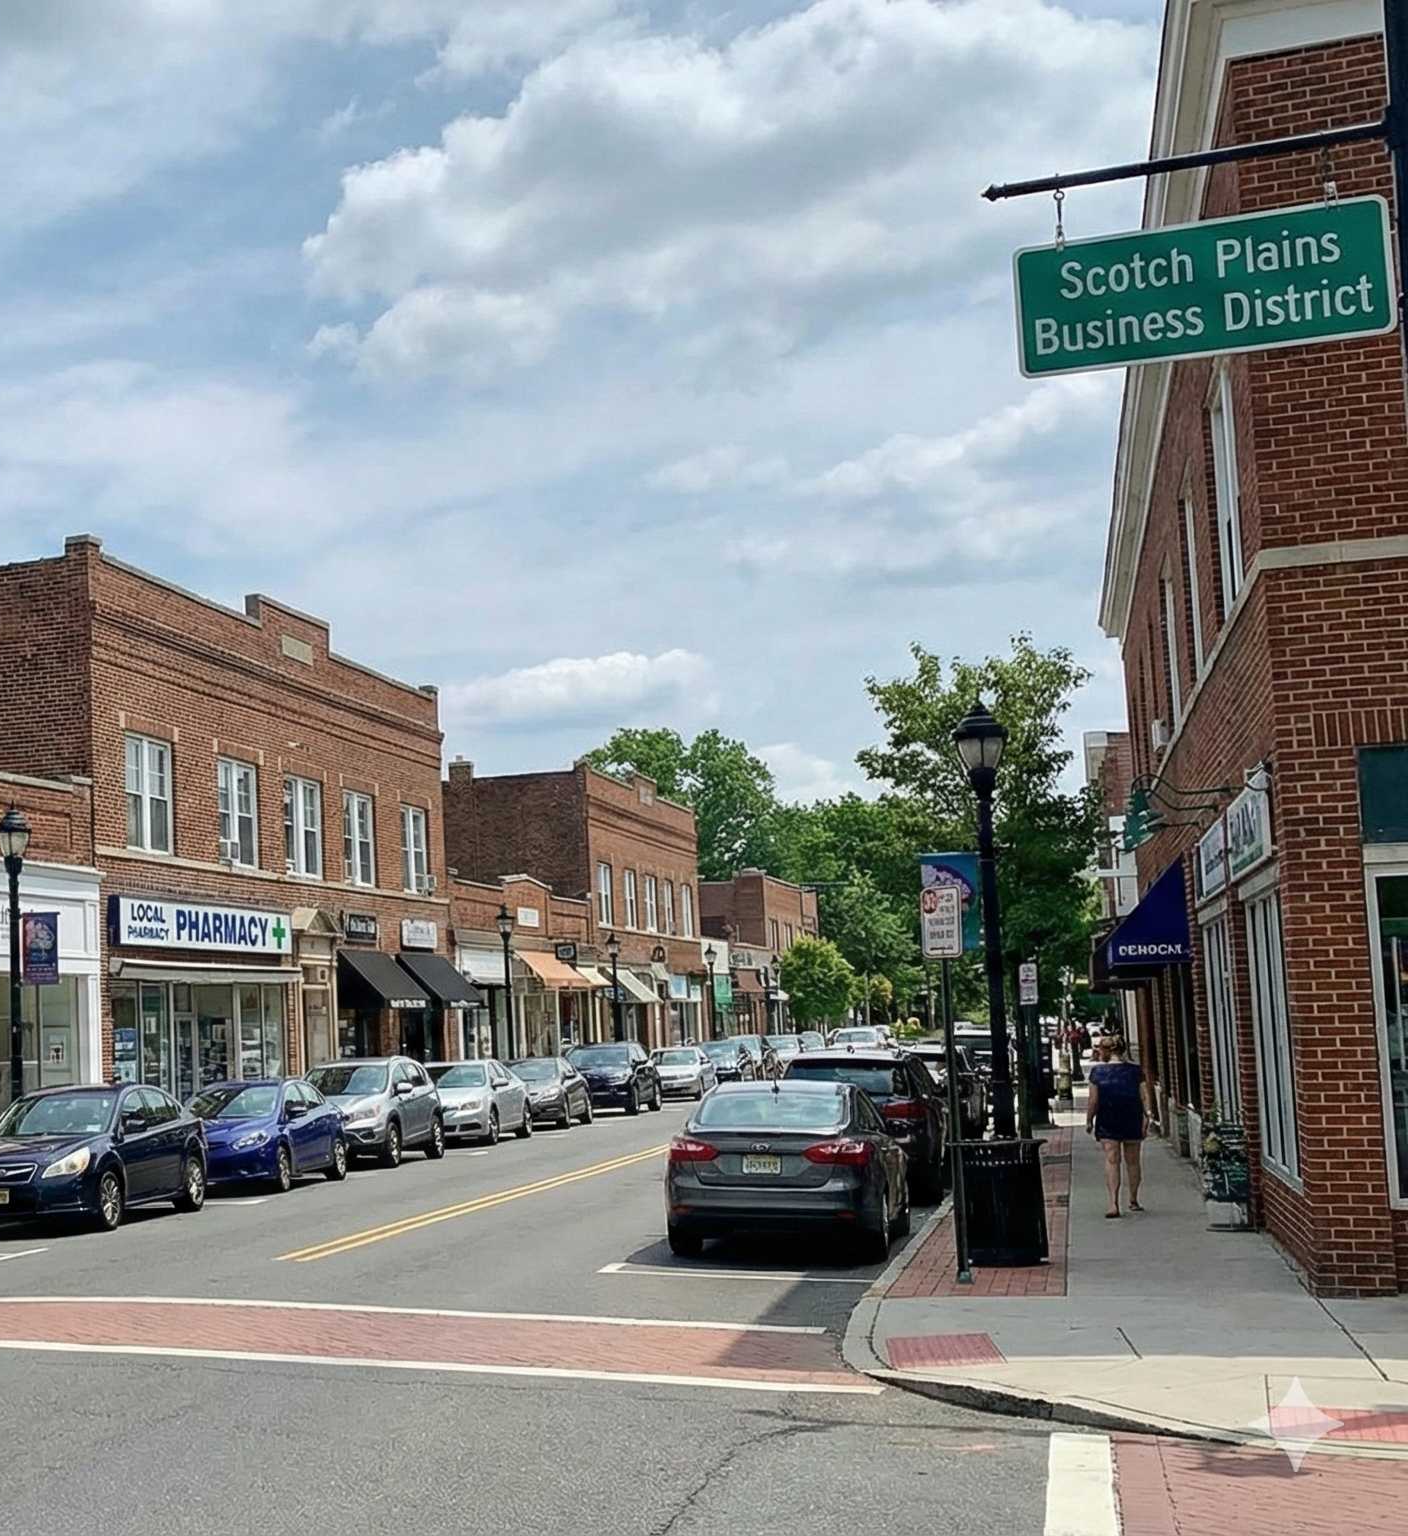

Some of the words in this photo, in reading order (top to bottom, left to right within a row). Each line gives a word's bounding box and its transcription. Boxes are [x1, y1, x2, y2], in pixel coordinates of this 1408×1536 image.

[1059, 247, 1193, 300] Scotch
[1216, 229, 1341, 278] Plains
[1035, 305, 1205, 356] Business
[1224, 274, 1375, 332] District
[130, 903, 166, 923] LOCAL
[175, 909, 268, 947] PHARMACY
